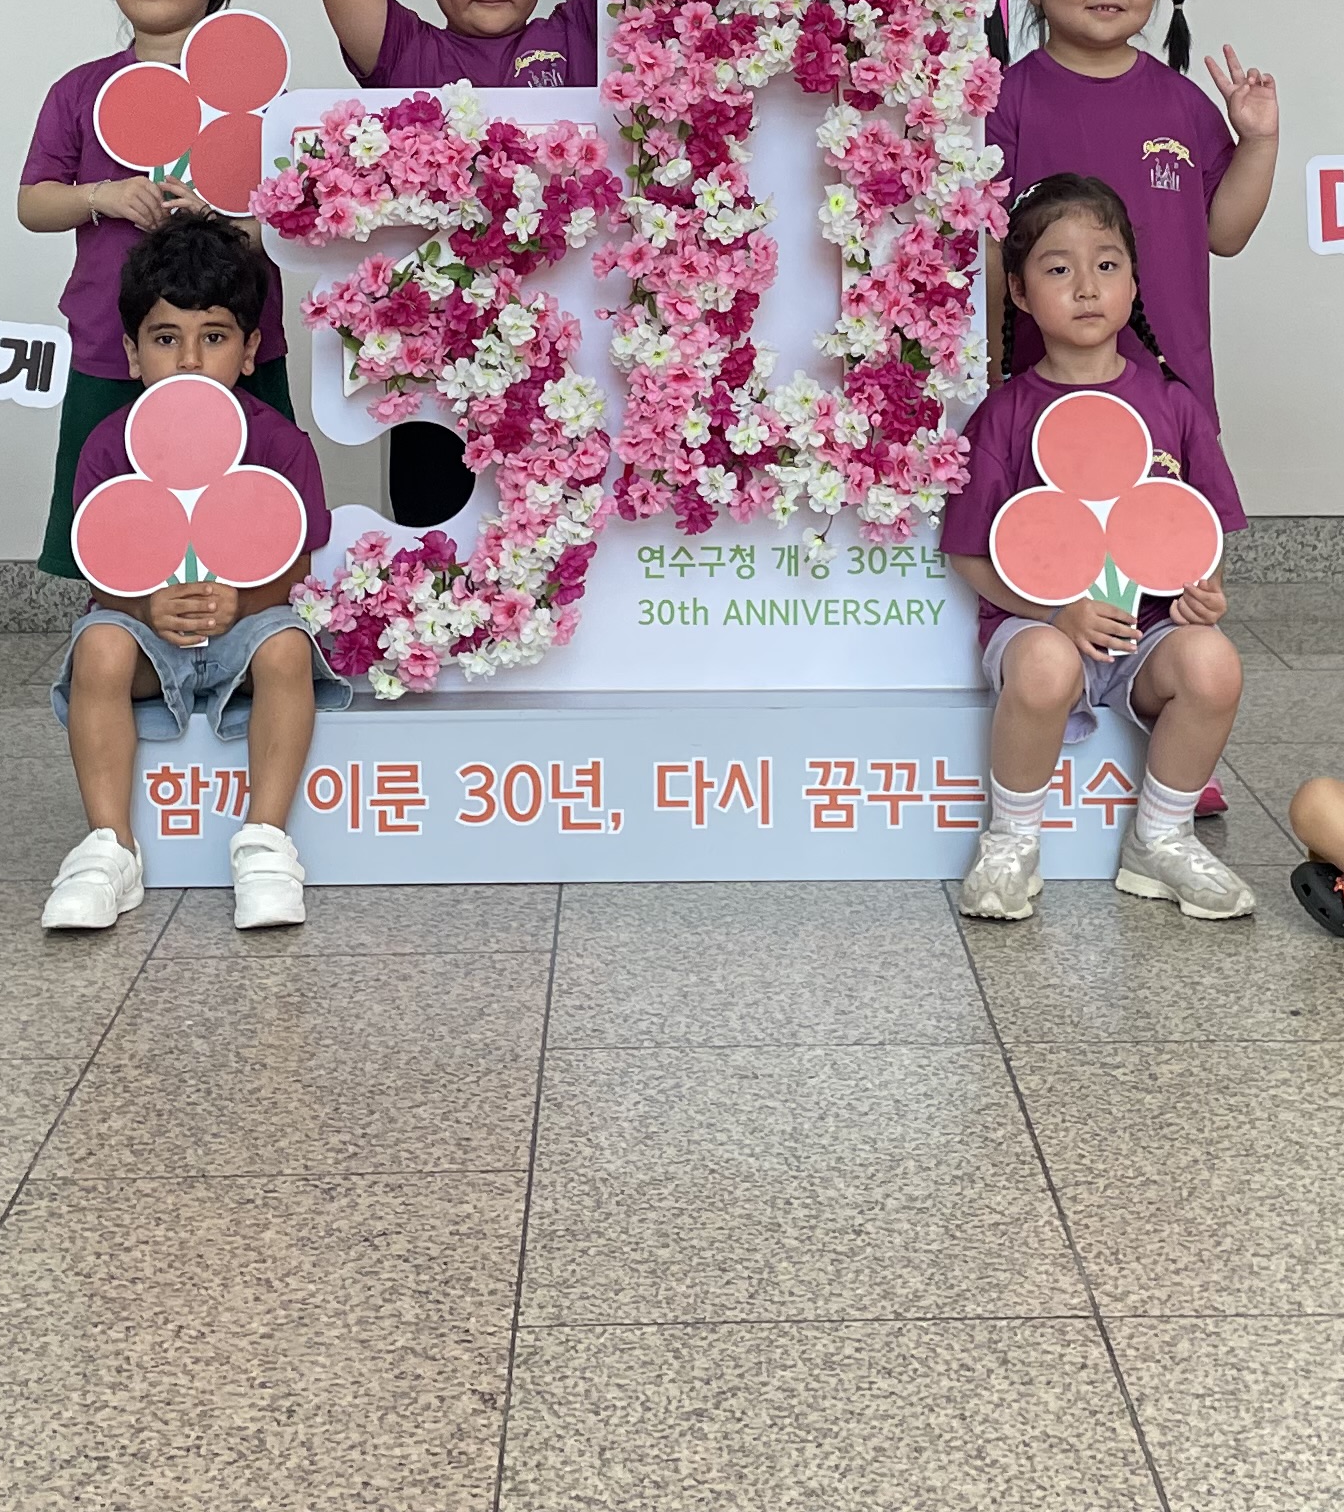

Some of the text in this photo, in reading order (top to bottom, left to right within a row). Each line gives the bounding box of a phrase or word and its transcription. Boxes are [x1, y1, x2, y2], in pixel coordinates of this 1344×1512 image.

[637, 544, 756, 580] 연수구청
[846, 545, 947, 580] 30주년
[638, 596, 947, 626] 30th ANNIVERSARY
[306, 763, 427, 833] 이룬
[459, 760, 622, 832] 30년,
[657, 759, 770, 826] 다시
[805, 759, 986, 829] 꿈꾸는
